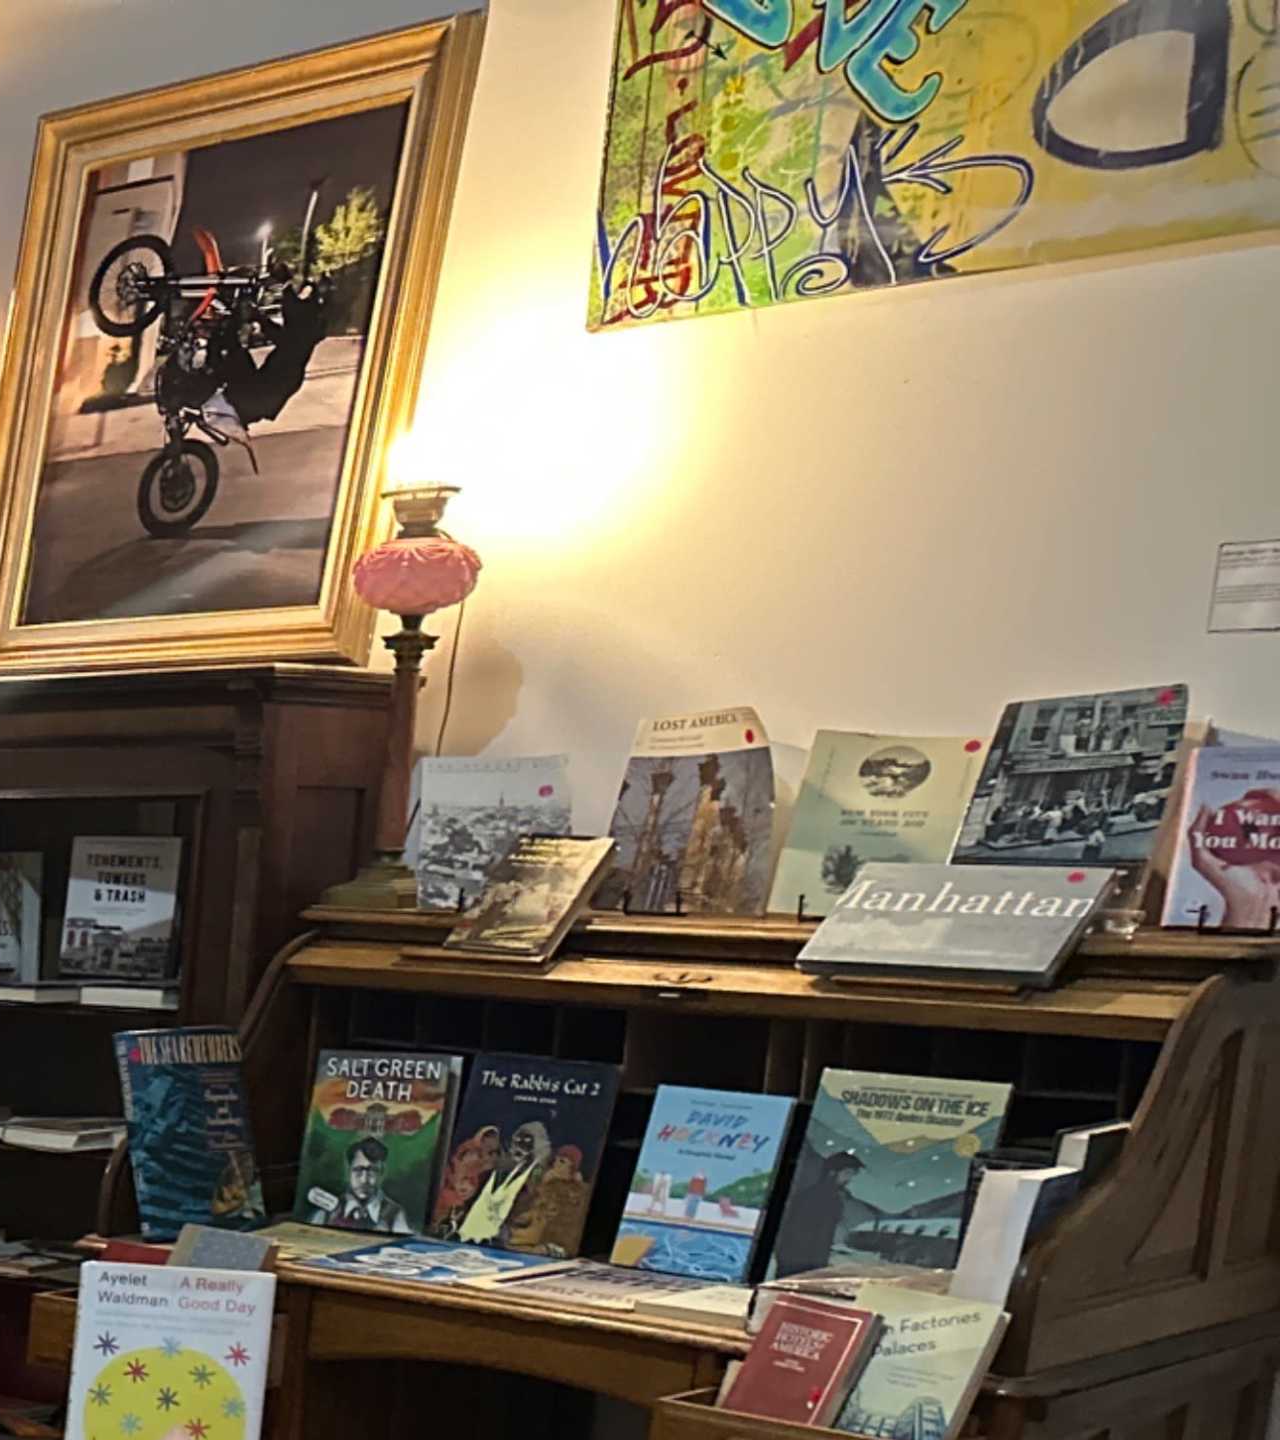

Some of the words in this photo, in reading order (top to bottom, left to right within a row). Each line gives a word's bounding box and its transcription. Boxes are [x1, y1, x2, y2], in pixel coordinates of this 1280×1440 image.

[652, 719, 687, 732] LOST
[1214, 808, 1225, 826] I
[1192, 831, 1237, 849] You
[107, 889, 146, 903] TRASH
[327, 1056, 369, 1078] SALT
[375, 1057, 441, 1080] GREEN
[345, 1080, 412, 1102] DEATH
[481, 1070, 507, 1089] The
[563, 1079, 587, 1095] Cat
[590, 1082, 600, 1096] 2
[841, 1090, 913, 1110] SHADOWS
[913, 1097, 937, 1112] ON
[938, 1099, 963, 1115] THE
[965, 1101, 990, 1117] ICE
[685, 1110, 749, 1129] DAVID
[657, 1124, 771, 1152] HOCKNEY
[98, 1271, 148, 1287] Ayelet
[179, 1276, 190, 1289] A
[195, 1277, 245, 1295] Really
[97, 1290, 169, 1307] Waldman
[178, 1296, 220, 1312] Good
[225, 1299, 257, 1316] Day
[900, 1311, 982, 1333] Factories
